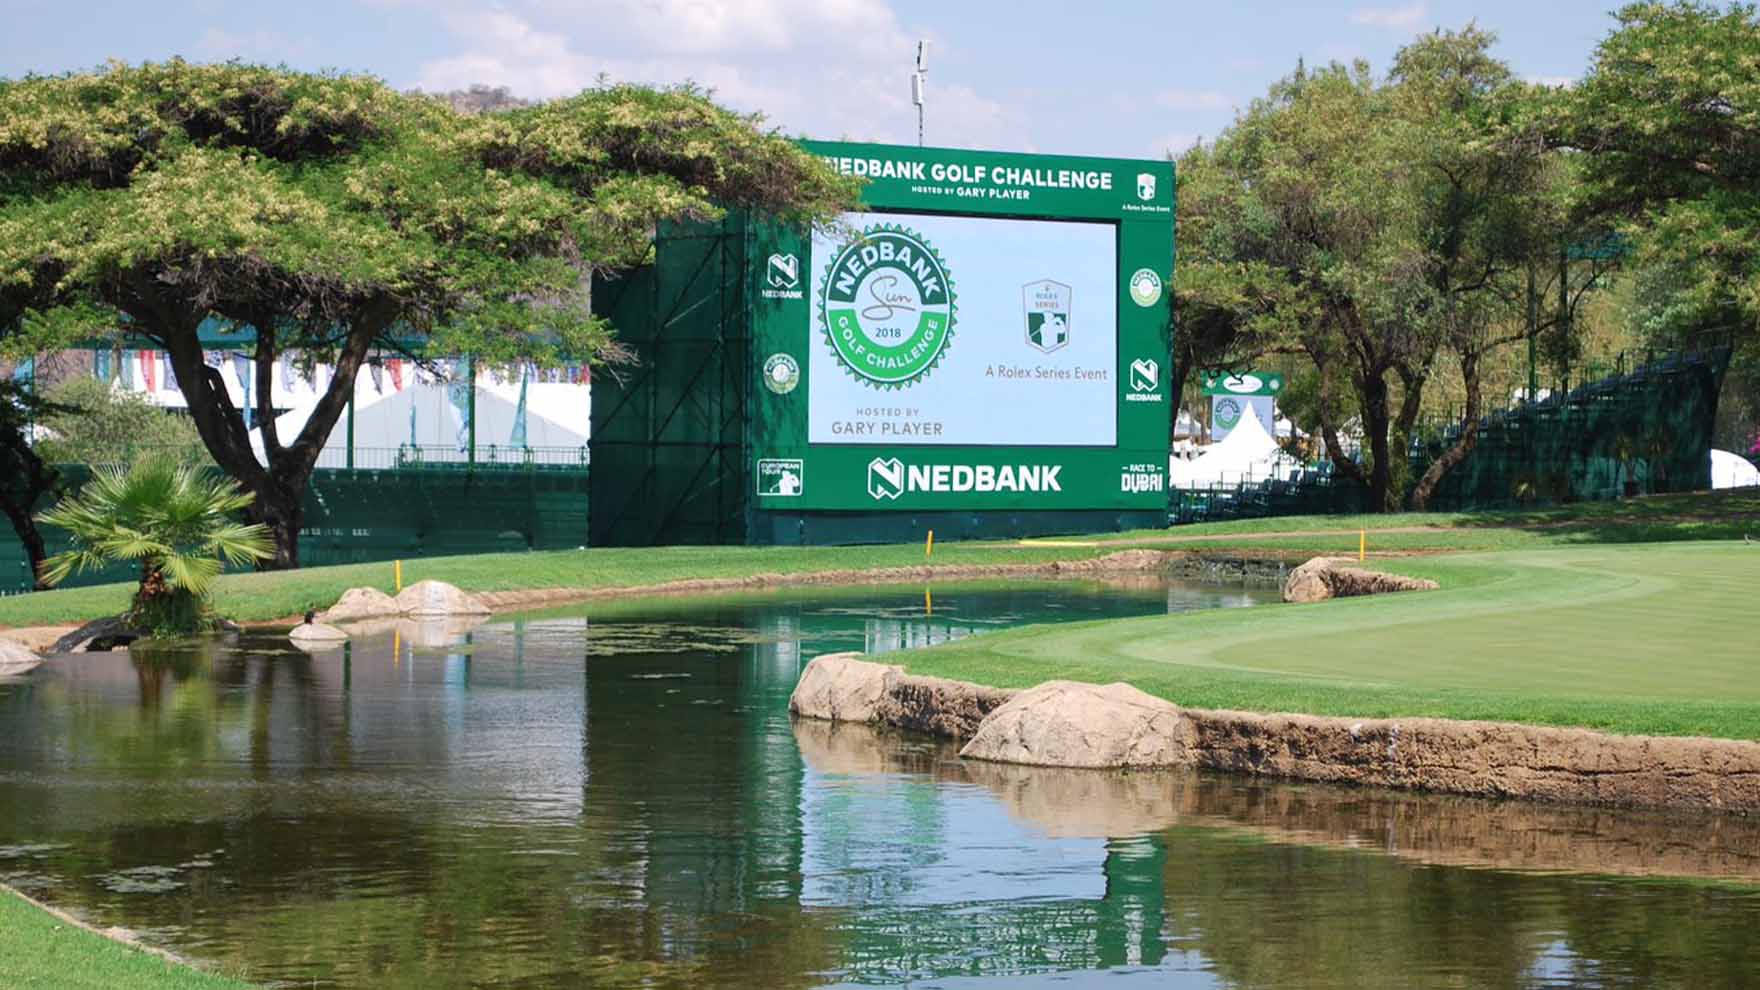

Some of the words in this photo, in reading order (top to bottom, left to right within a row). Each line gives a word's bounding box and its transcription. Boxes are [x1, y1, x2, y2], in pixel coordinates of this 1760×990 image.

[931, 163, 986, 183] GOLF
[991, 166, 1113, 190] CHALLENGE
[911, 186, 942, 194] HOSTED
[956, 186, 987, 197] GARY
[989, 188, 1030, 200] PLAYER
[835, 242, 941, 298] NEDBANK
[762, 290, 803, 298] NEDBANK
[875, 328, 902, 338] 2018
[838, 316, 866, 356] GOLF
[866, 319, 939, 369] CHALLENGE
[985, 365, 994, 377] A
[998, 365, 1032, 378] Rolex
[1035, 366, 1071, 379] Series
[1074, 367, 1108, 380] Event
[856, 408, 902, 416] HOSTED
[906, 408, 920, 416] BY
[831, 422, 875, 434] GARY
[881, 422, 944, 436] PLAYER
[1129, 464, 1146, 472] RACE
[1147, 464, 1156, 472] TO
[908, 465, 1062, 492] NEDBANK
[1121, 473, 1163, 493] DUBAI
